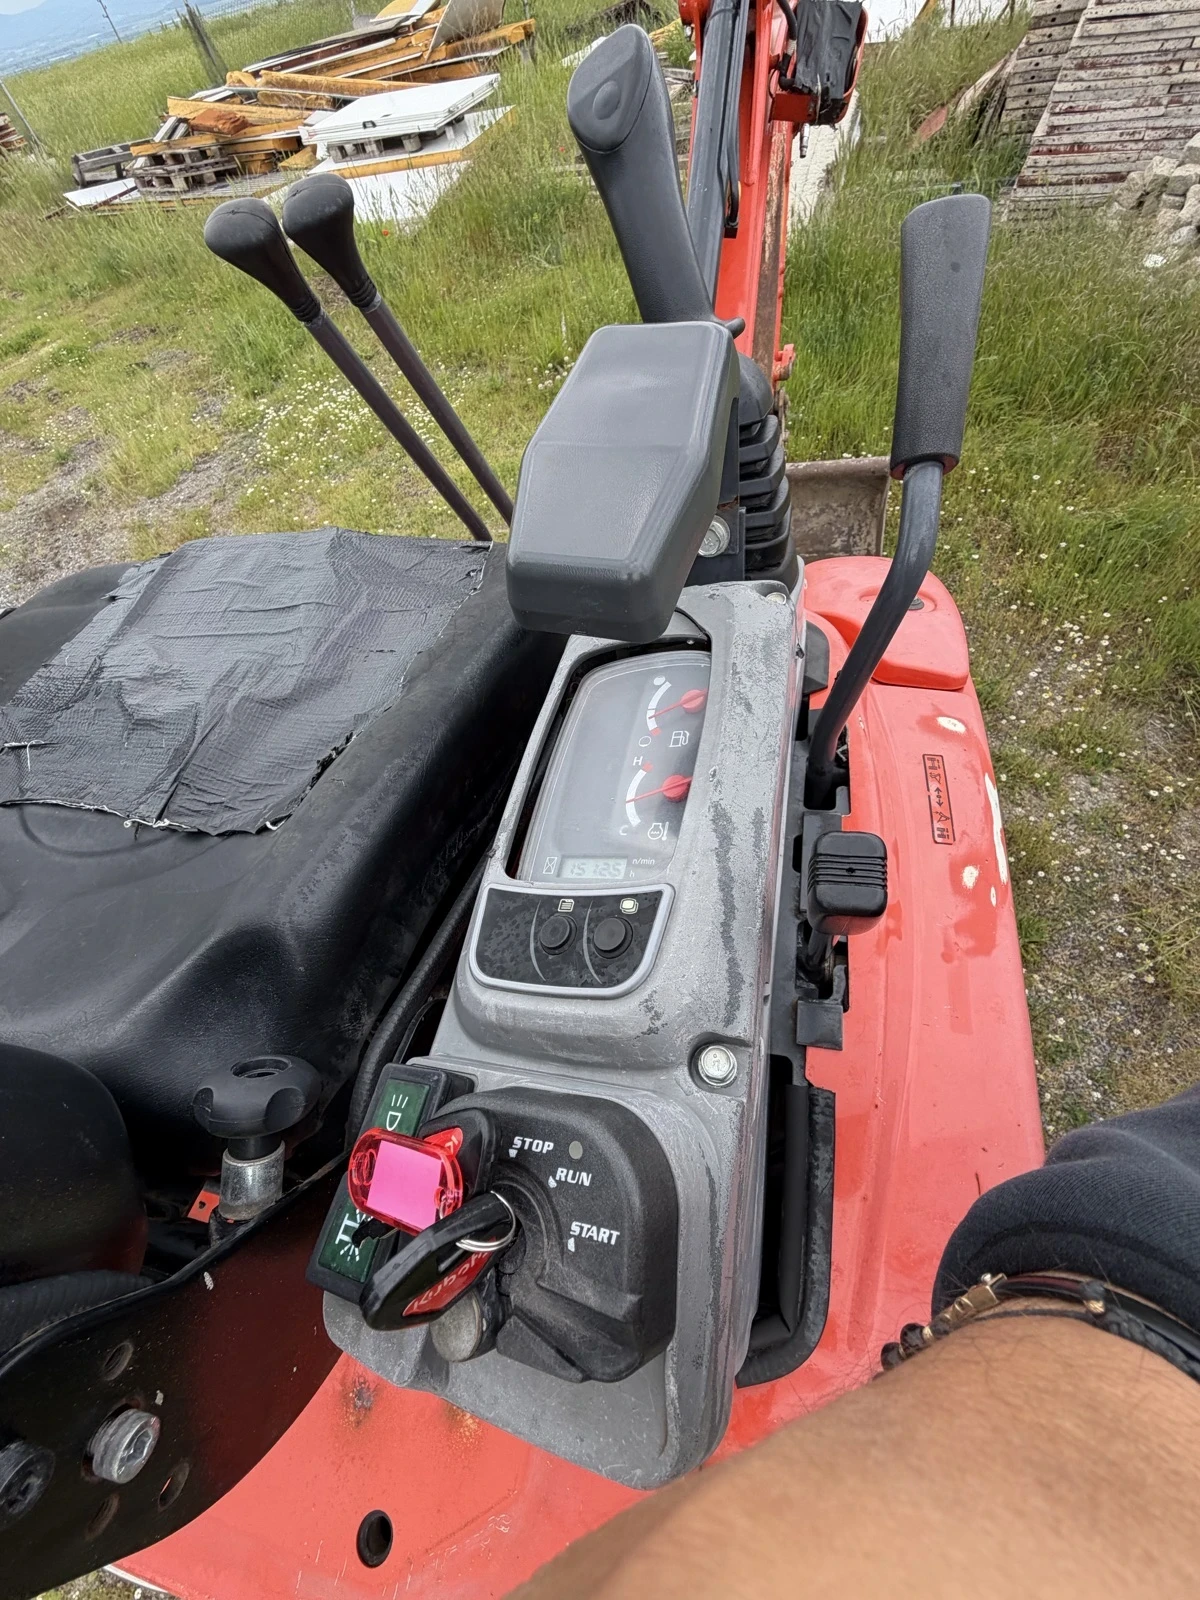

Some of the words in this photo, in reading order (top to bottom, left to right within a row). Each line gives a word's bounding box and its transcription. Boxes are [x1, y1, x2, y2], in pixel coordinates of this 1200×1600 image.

[633, 756, 643, 766] H
[619, 824, 629, 836] C
[632, 857, 656, 866] n/min
[629, 870, 635, 878] h
[512, 1136, 554, 1153] STOP
[555, 1167, 592, 1187] RUN
[569, 1221, 620, 1245] START
